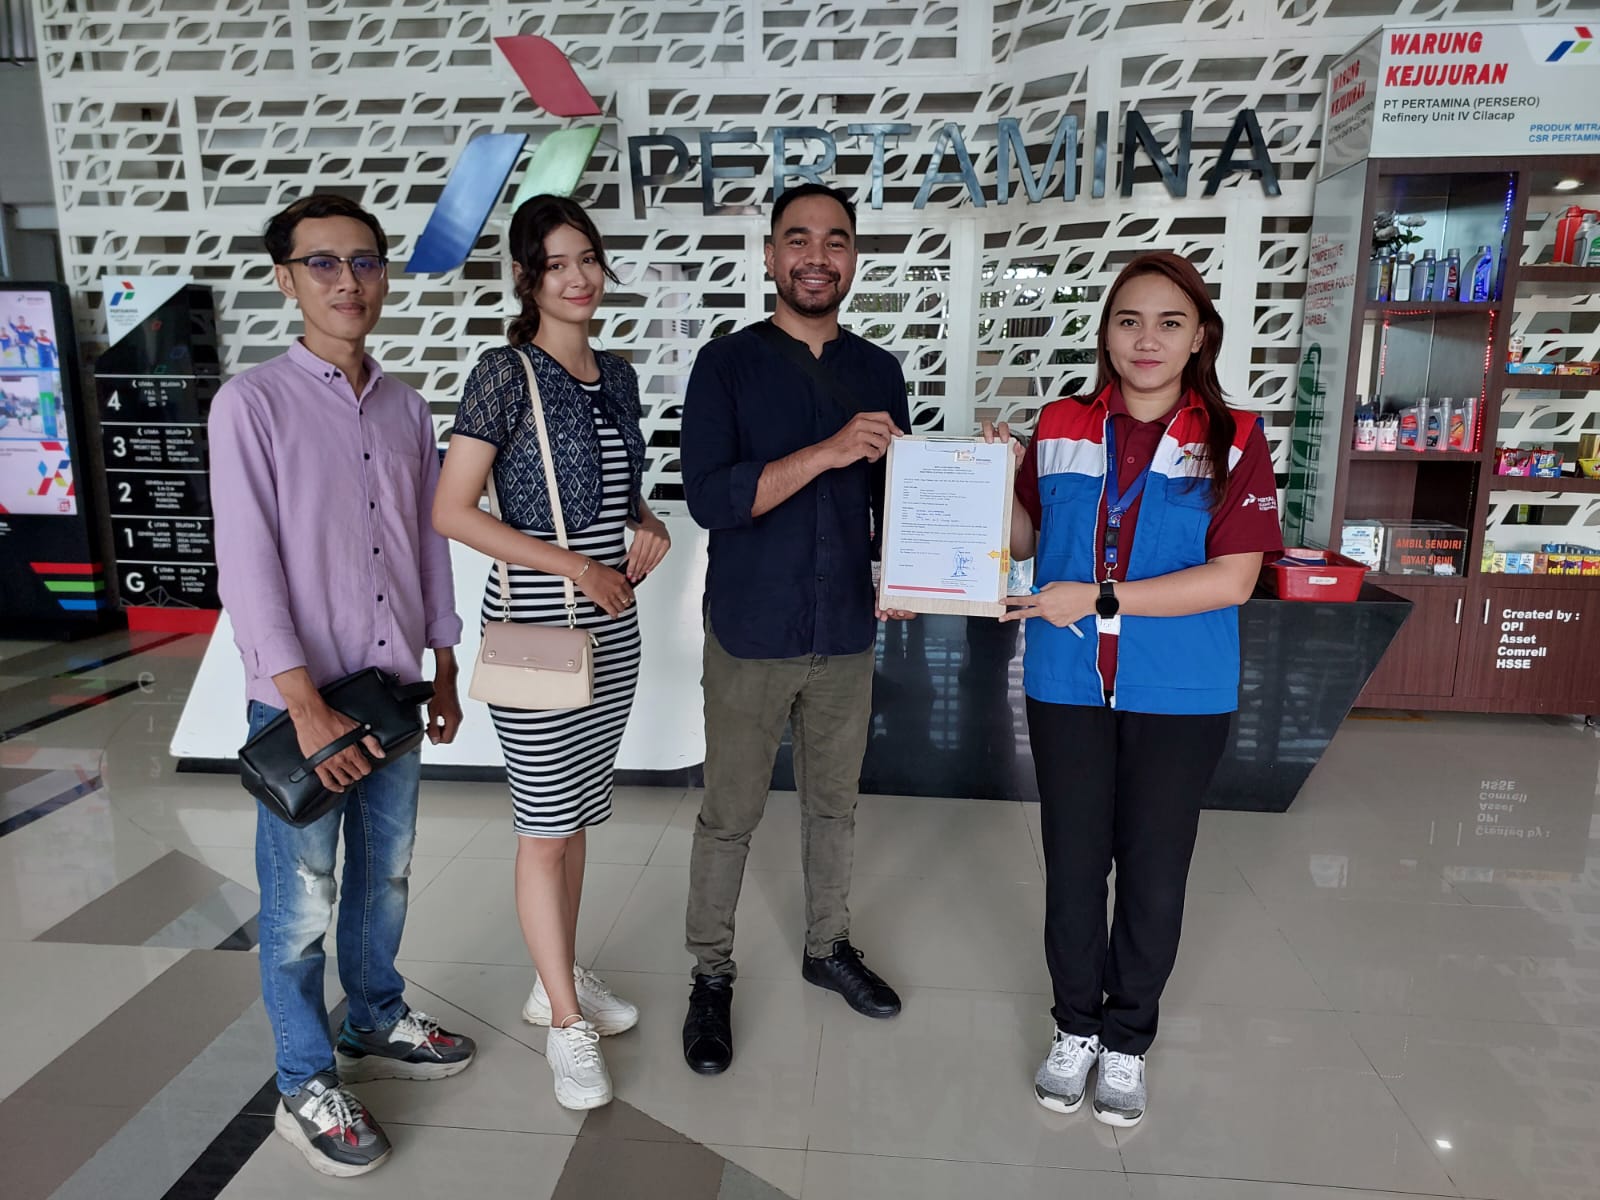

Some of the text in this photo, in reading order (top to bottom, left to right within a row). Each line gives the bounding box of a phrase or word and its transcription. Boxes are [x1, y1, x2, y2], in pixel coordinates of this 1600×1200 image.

[1390, 32, 1483, 55] WARUNG
[1385, 63, 1509, 87] KEJUJURAN
[1383, 96, 1540, 109] PT PERTAMINA (PERSERO)
[1382, 111, 1516, 123] Refinery Unit IV Cilacap
[1530, 123, 1572, 132] PRODUK
[1528, 133, 1600, 142] CSR PERTAMIN
[628, 109, 1281, 220] PERTAMINA
[107, 390, 122, 411] 4
[112, 436, 127, 457] 3
[118, 482, 133, 503] 2
[124, 528, 134, 548] 1
[1395, 539, 1462, 550] AMBIL SENDIRI
[1400, 555, 1453, 565] BAYAR DISINI
[126, 572, 145, 593] G
[1502, 608, 1553, 620] Created
[1557, 609, 1572, 622] by
[1501, 622, 1524, 632] OPI
[1499, 634, 1537, 644] Asset
[1497, 646, 1547, 657] Comrell
[1496, 659, 1531, 669] HSSE
